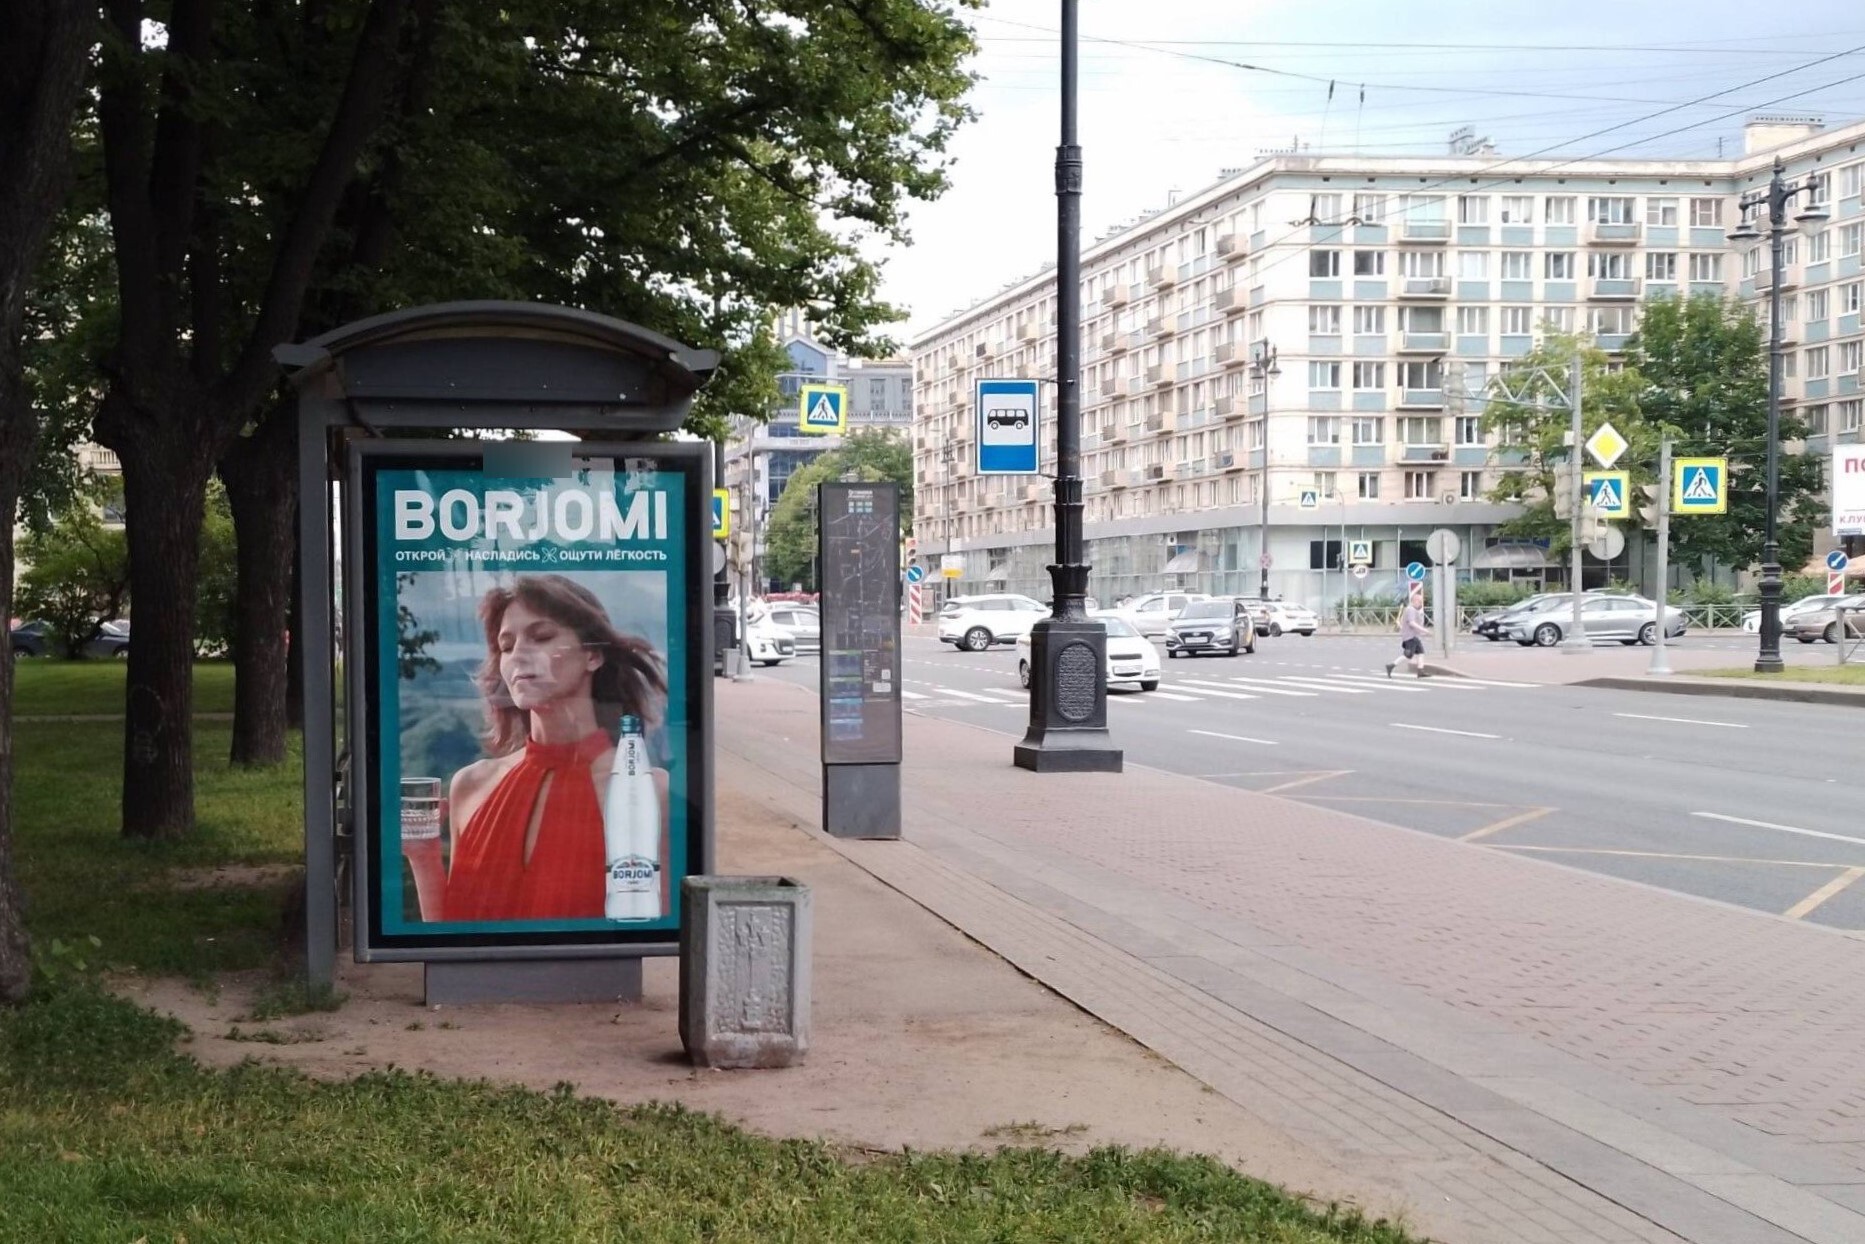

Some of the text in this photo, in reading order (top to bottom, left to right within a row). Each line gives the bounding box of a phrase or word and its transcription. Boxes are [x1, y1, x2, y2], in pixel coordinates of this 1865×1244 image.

[395, 489, 667, 540] BORJOMI
[395, 549, 446, 561] ОТКРОЙ
[465, 550, 541, 562] НАСЛАДИСЬ
[559, 550, 603, 562] ОЩУТИ
